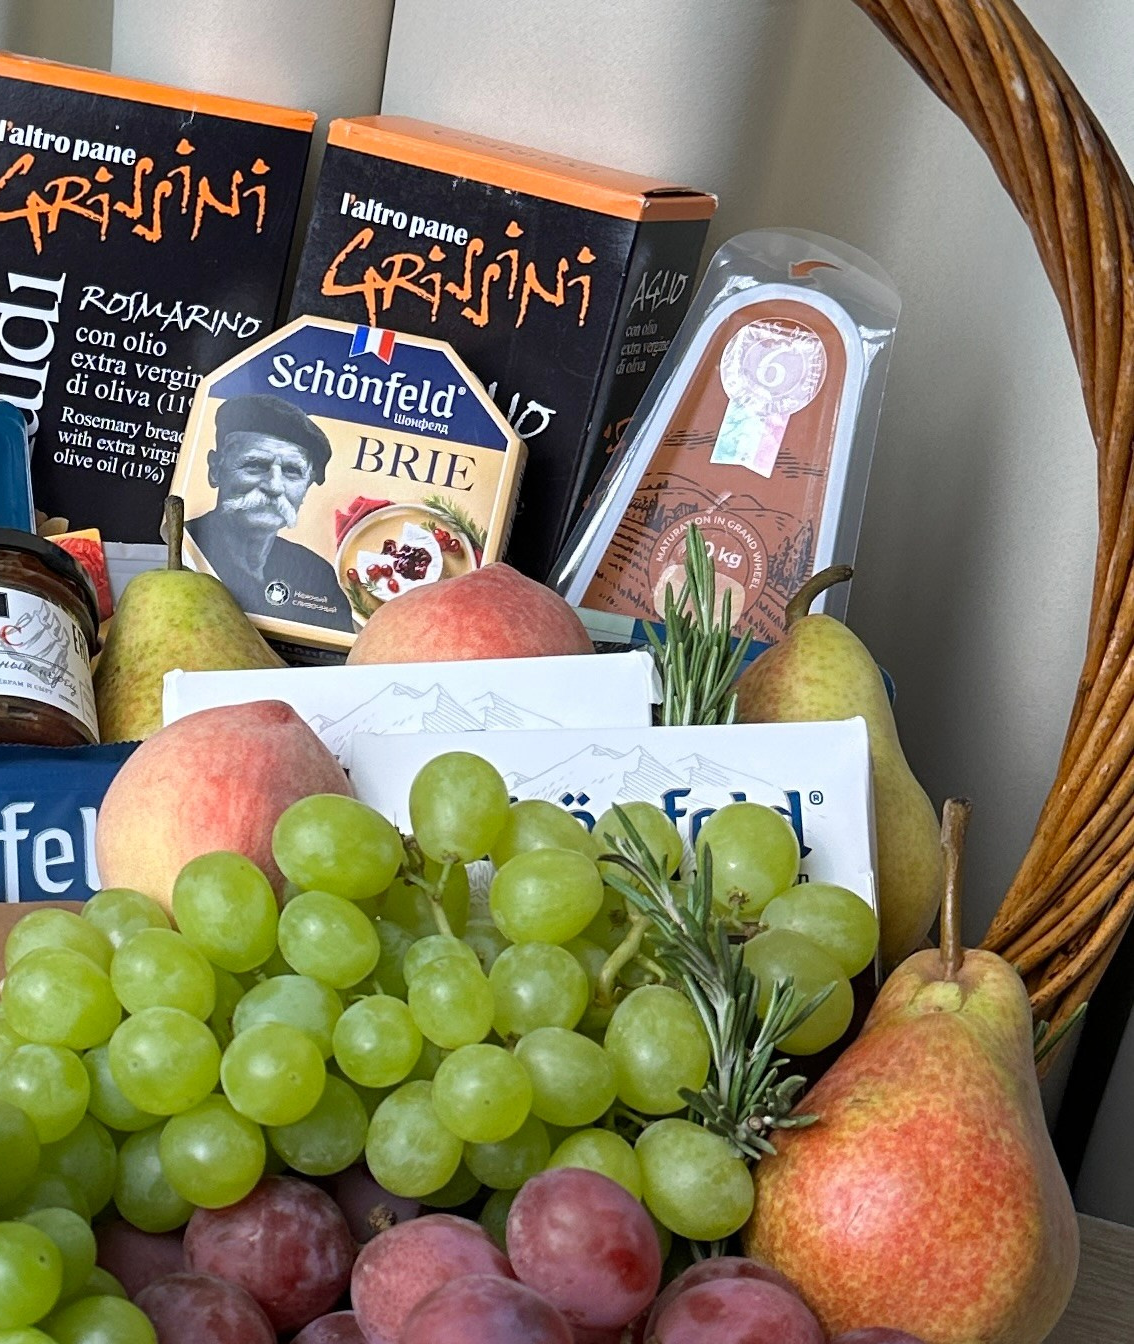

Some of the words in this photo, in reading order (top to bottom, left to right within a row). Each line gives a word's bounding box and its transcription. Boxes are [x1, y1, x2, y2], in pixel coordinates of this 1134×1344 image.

[72, 138, 137, 166] pane
[340, 192, 407, 230] l'altro
[408, 214, 469, 246] pane
[79, 285, 262, 339] ROSMARINO
[626, 270, 689, 318] AGLIO
[75, 326, 116, 348] con
[123, 331, 167, 357] olio
[70, 351, 127, 376] extra
[135, 363, 204, 391] vergin
[756, 345, 788, 388] 6
[65, 373, 88, 396] di
[95, 379, 150, 407] oliva
[156, 392, 194, 415] (11
[57, 429, 92, 448] with
[96, 436, 135, 456] extra
[60, 406, 142, 439] Rosemary
[393, 412, 449, 435] Шонфелд
[53, 449, 93, 469] olive
[96, 455, 117, 474] oil
[121, 461, 165, 485] (11%)
[351, 435, 477, 492] BRIE
[656, 516, 711, 562] MATURATON
[713, 516, 726, 525] IN
[727, 520, 758, 550] GRAND
[749, 550, 763, 590] WHEEL
[718, 546, 742, 569] kg
